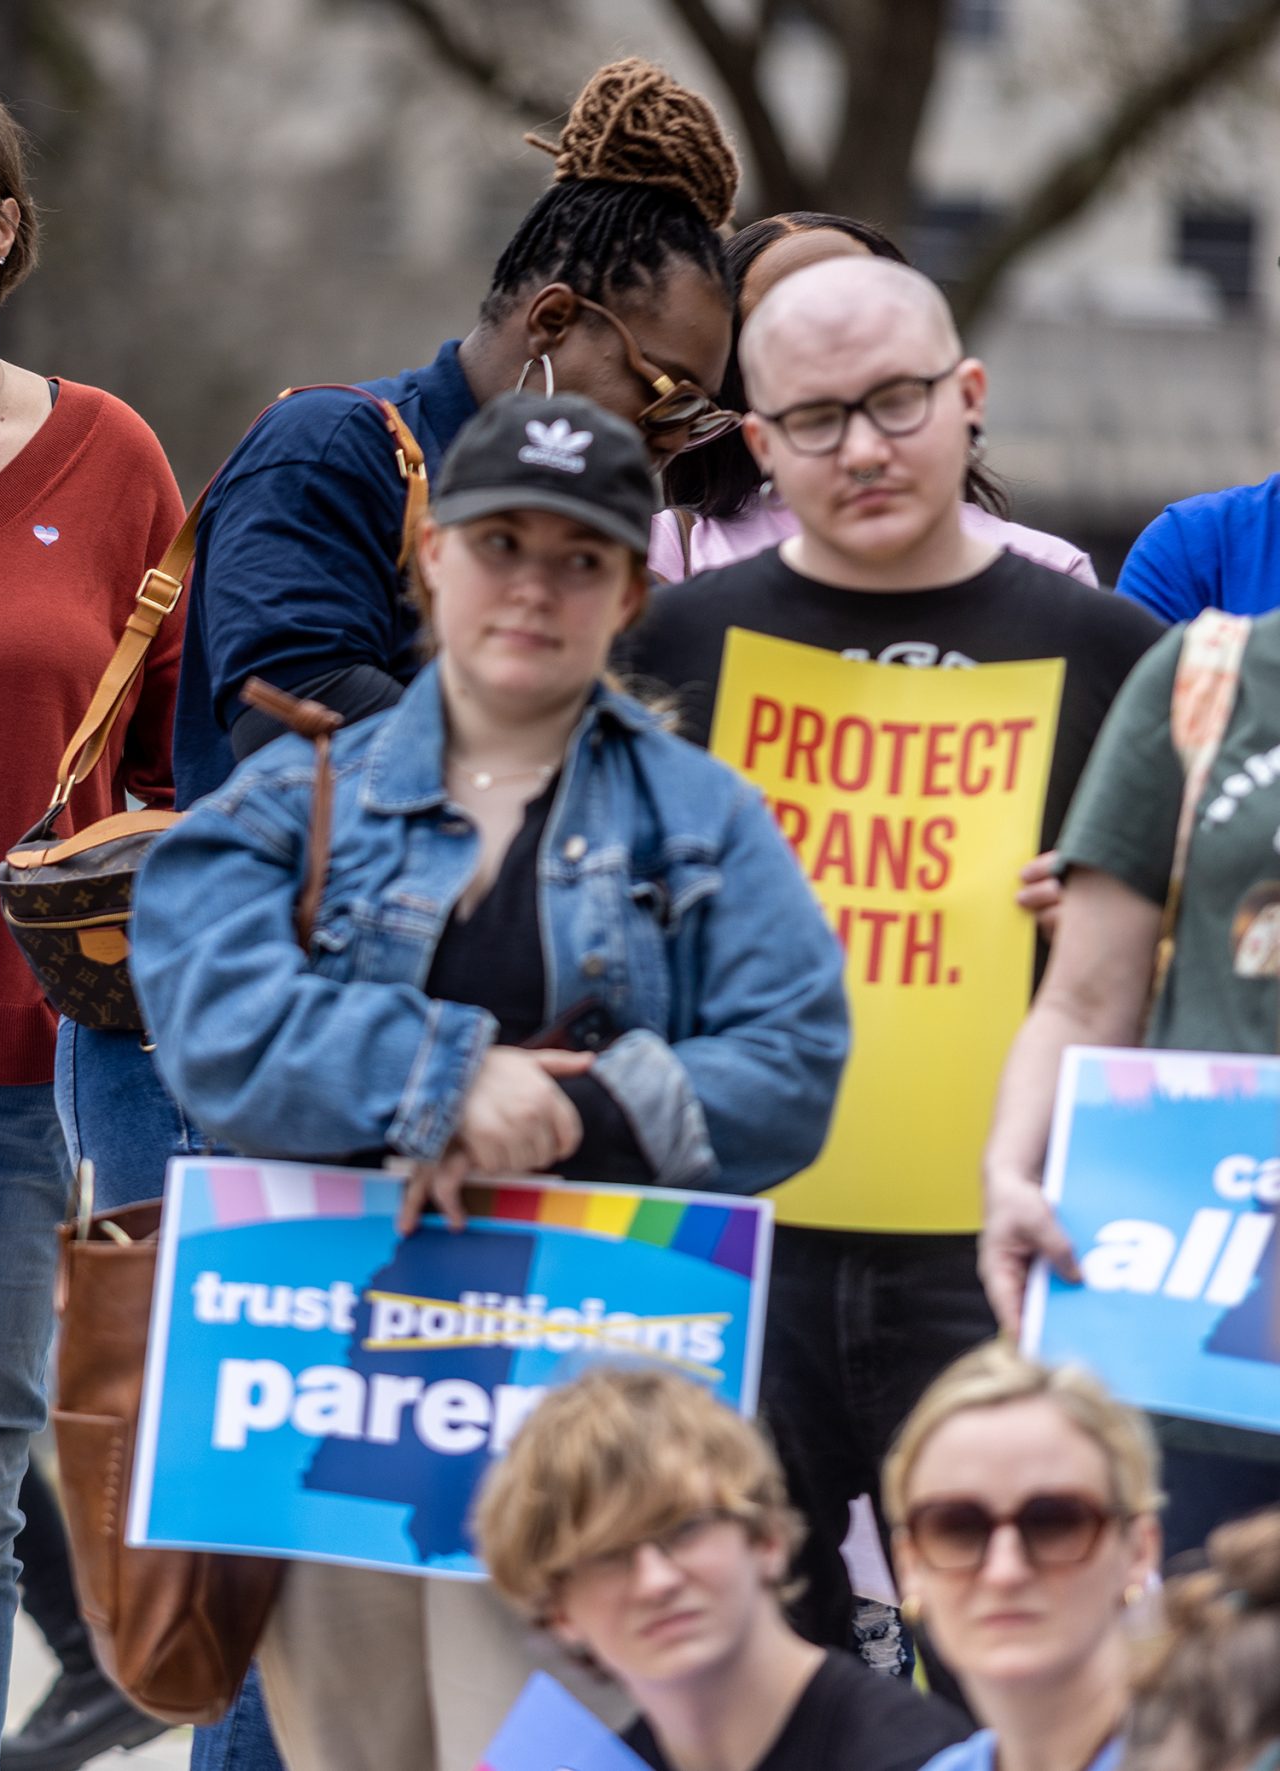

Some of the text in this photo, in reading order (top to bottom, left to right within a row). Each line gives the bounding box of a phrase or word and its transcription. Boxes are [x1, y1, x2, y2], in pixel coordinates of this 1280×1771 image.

[744, 694, 1036, 798] PROTECT
[762, 797, 958, 892] RANS
[1081, 1207, 1274, 1307] all
[192, 1270, 726, 1364] trust politicians
